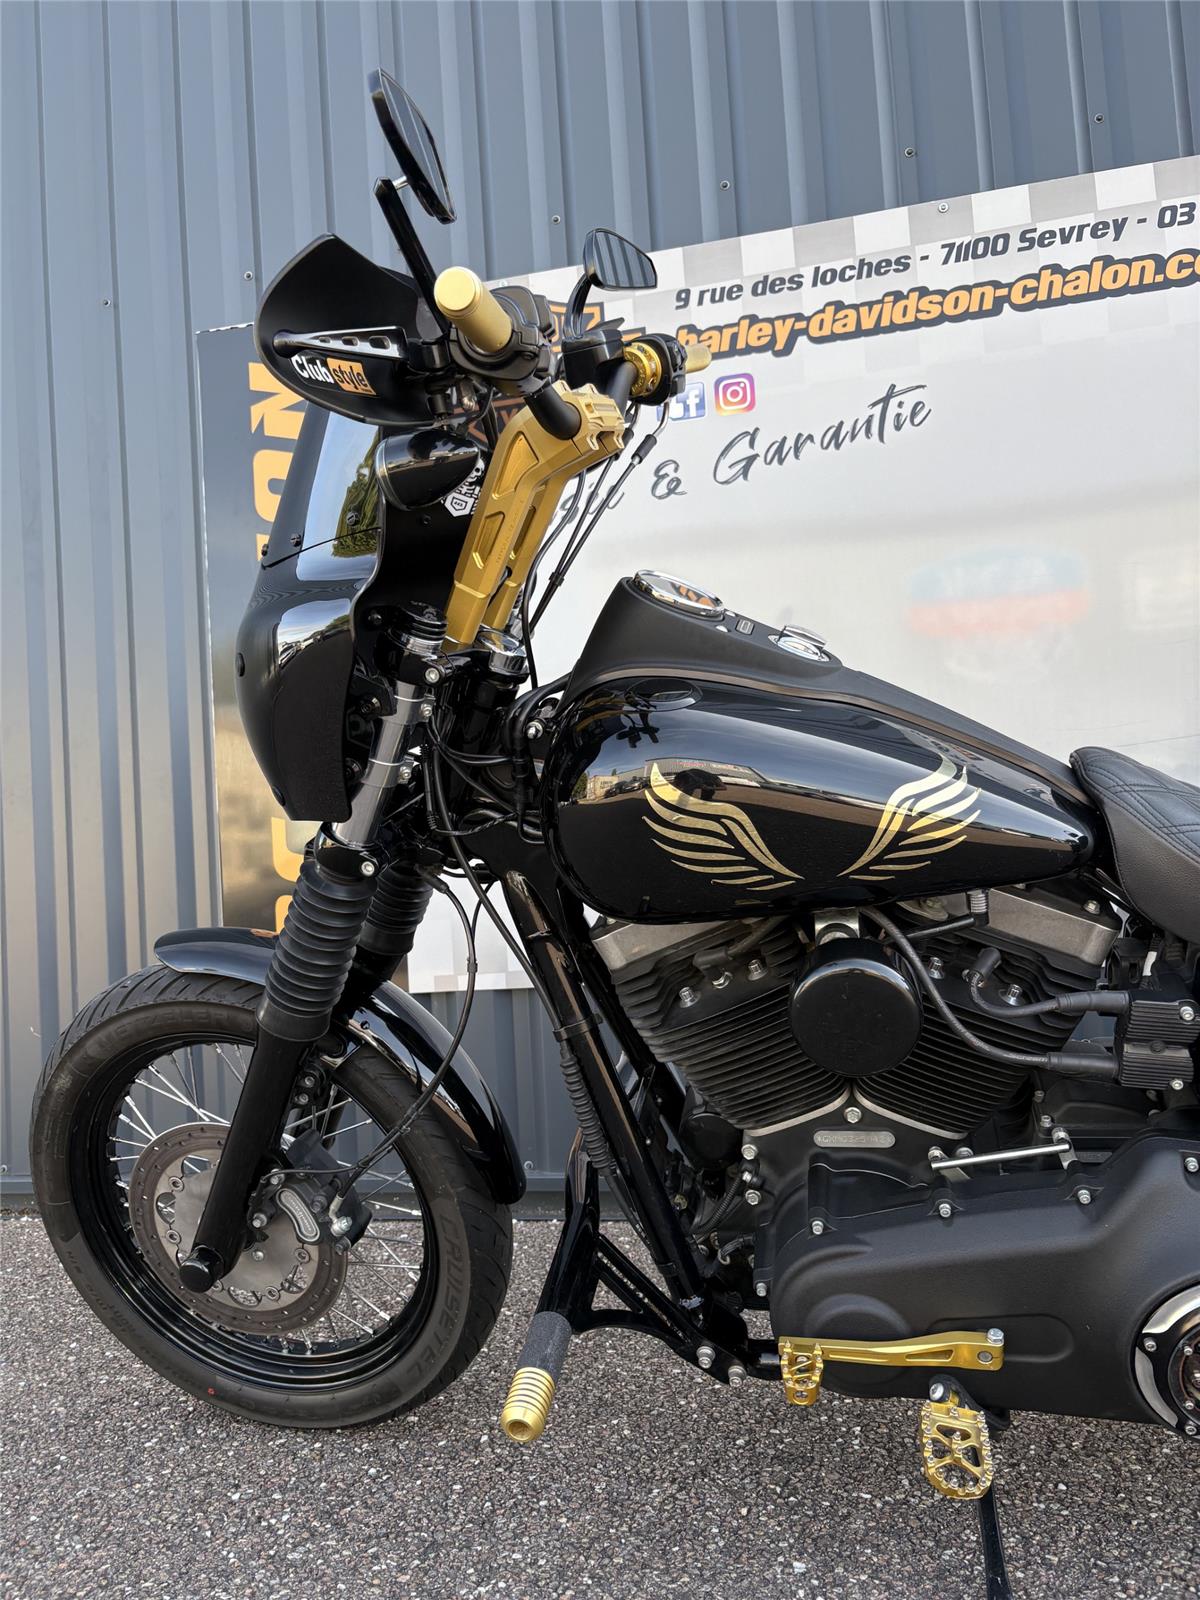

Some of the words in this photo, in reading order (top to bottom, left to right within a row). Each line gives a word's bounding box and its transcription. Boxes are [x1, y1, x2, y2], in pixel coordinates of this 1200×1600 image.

[675, 288, 691, 310] 9
[697, 284, 743, 306] rue
[751, 274, 804, 297] des
[811, 255, 911, 288] loches
[940, 232, 1011, 265] 71100
[1017, 217, 1128, 252] Sevrey
[1137, 217, 1148, 225] -
[1157, 201, 1197, 229] 03
[676, 251, 1200, 353] harley-davidson-chalon.c
[291, 354, 335, 384] Club
[333, 364, 369, 390] style
[651, 459, 687, 500] &
[712, 383, 932, 487] Garantie
